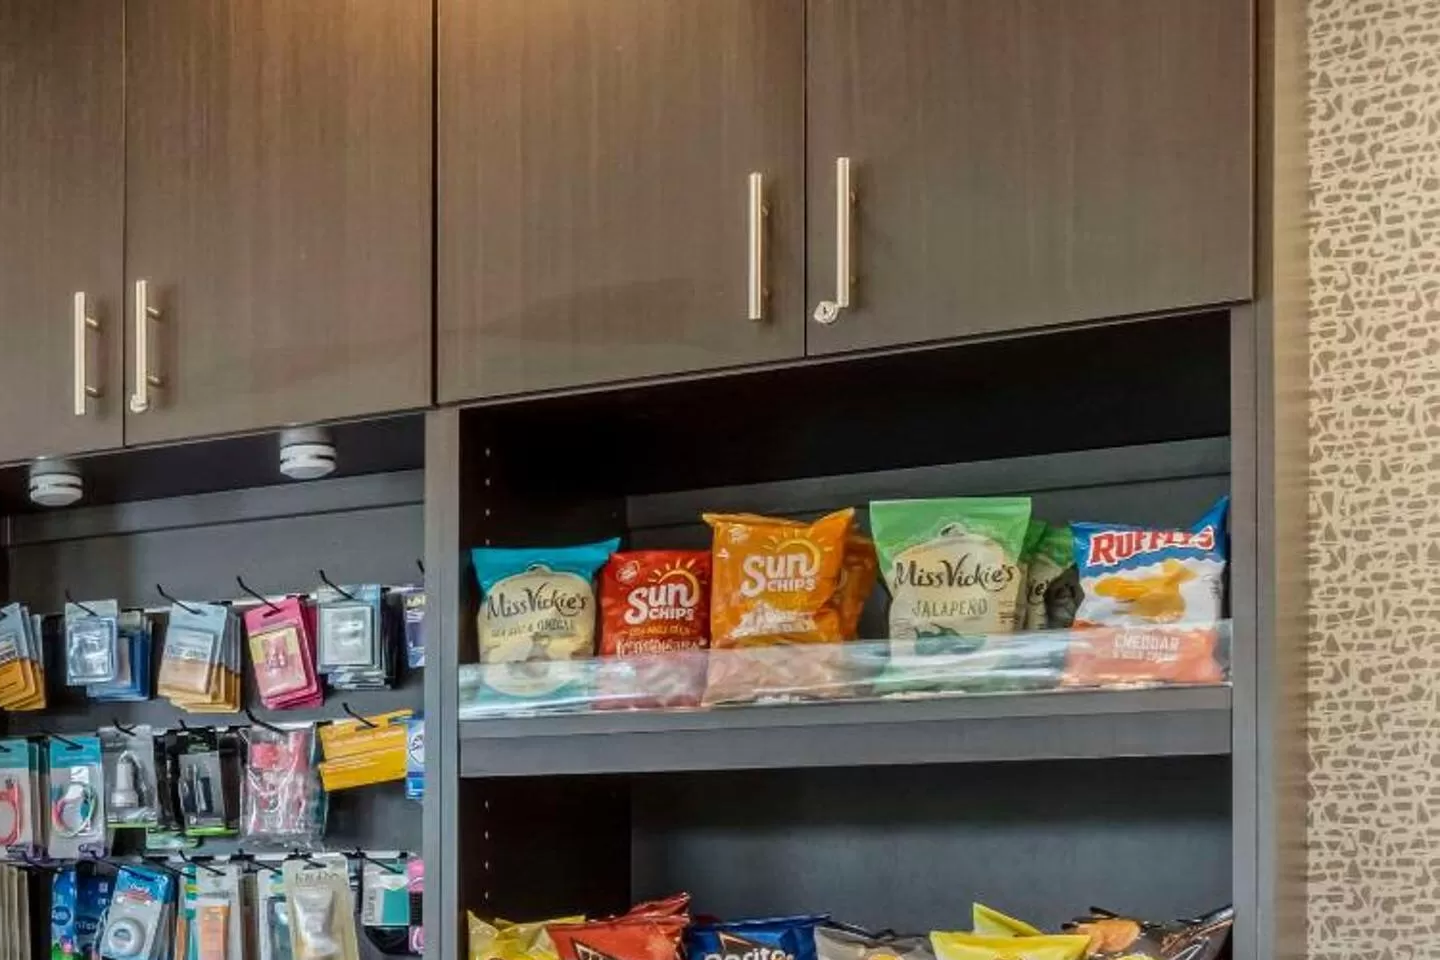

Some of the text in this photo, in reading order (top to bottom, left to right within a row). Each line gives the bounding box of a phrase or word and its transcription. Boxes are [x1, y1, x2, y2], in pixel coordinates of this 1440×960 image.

[741, 552, 816, 598] Sun
[767, 580, 816, 592] CHIPS
[894, 560, 943, 589] Miss
[940, 553, 1015, 592] Vickie's
[487, 581, 590, 620] Miss Vickie's
[624, 582, 688, 625] Sun
[648, 607, 694, 620] CHIPS
